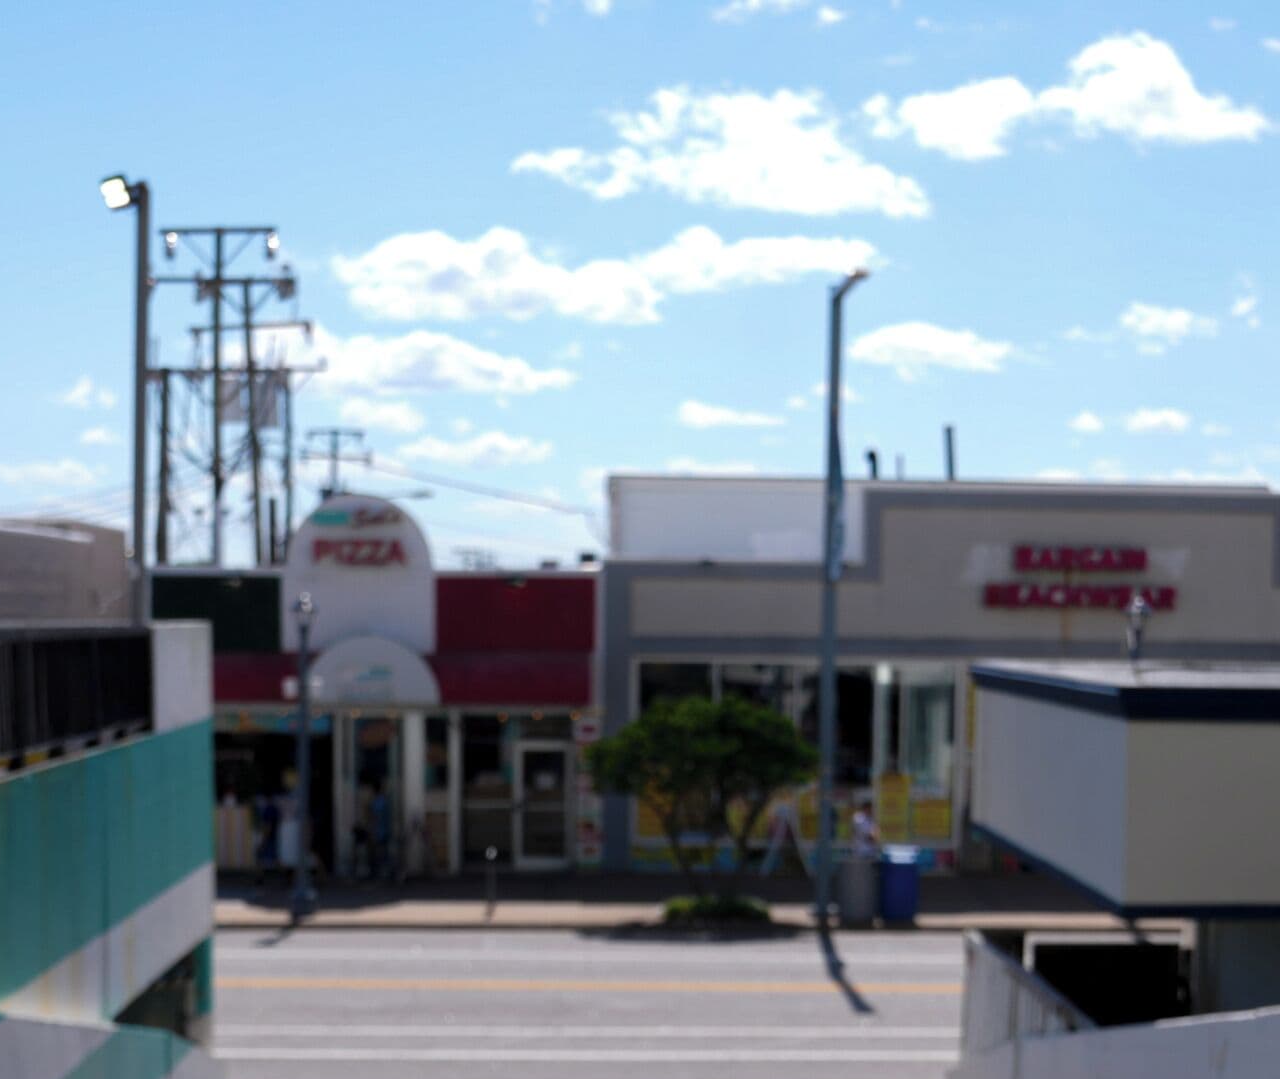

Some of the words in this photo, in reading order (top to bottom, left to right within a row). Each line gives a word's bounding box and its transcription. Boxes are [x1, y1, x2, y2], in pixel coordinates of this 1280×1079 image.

[312, 539, 408, 567] PIZZA
[1014, 545, 1148, 572] BARGAIN
[984, 584, 1176, 610] BEACHWEAR
